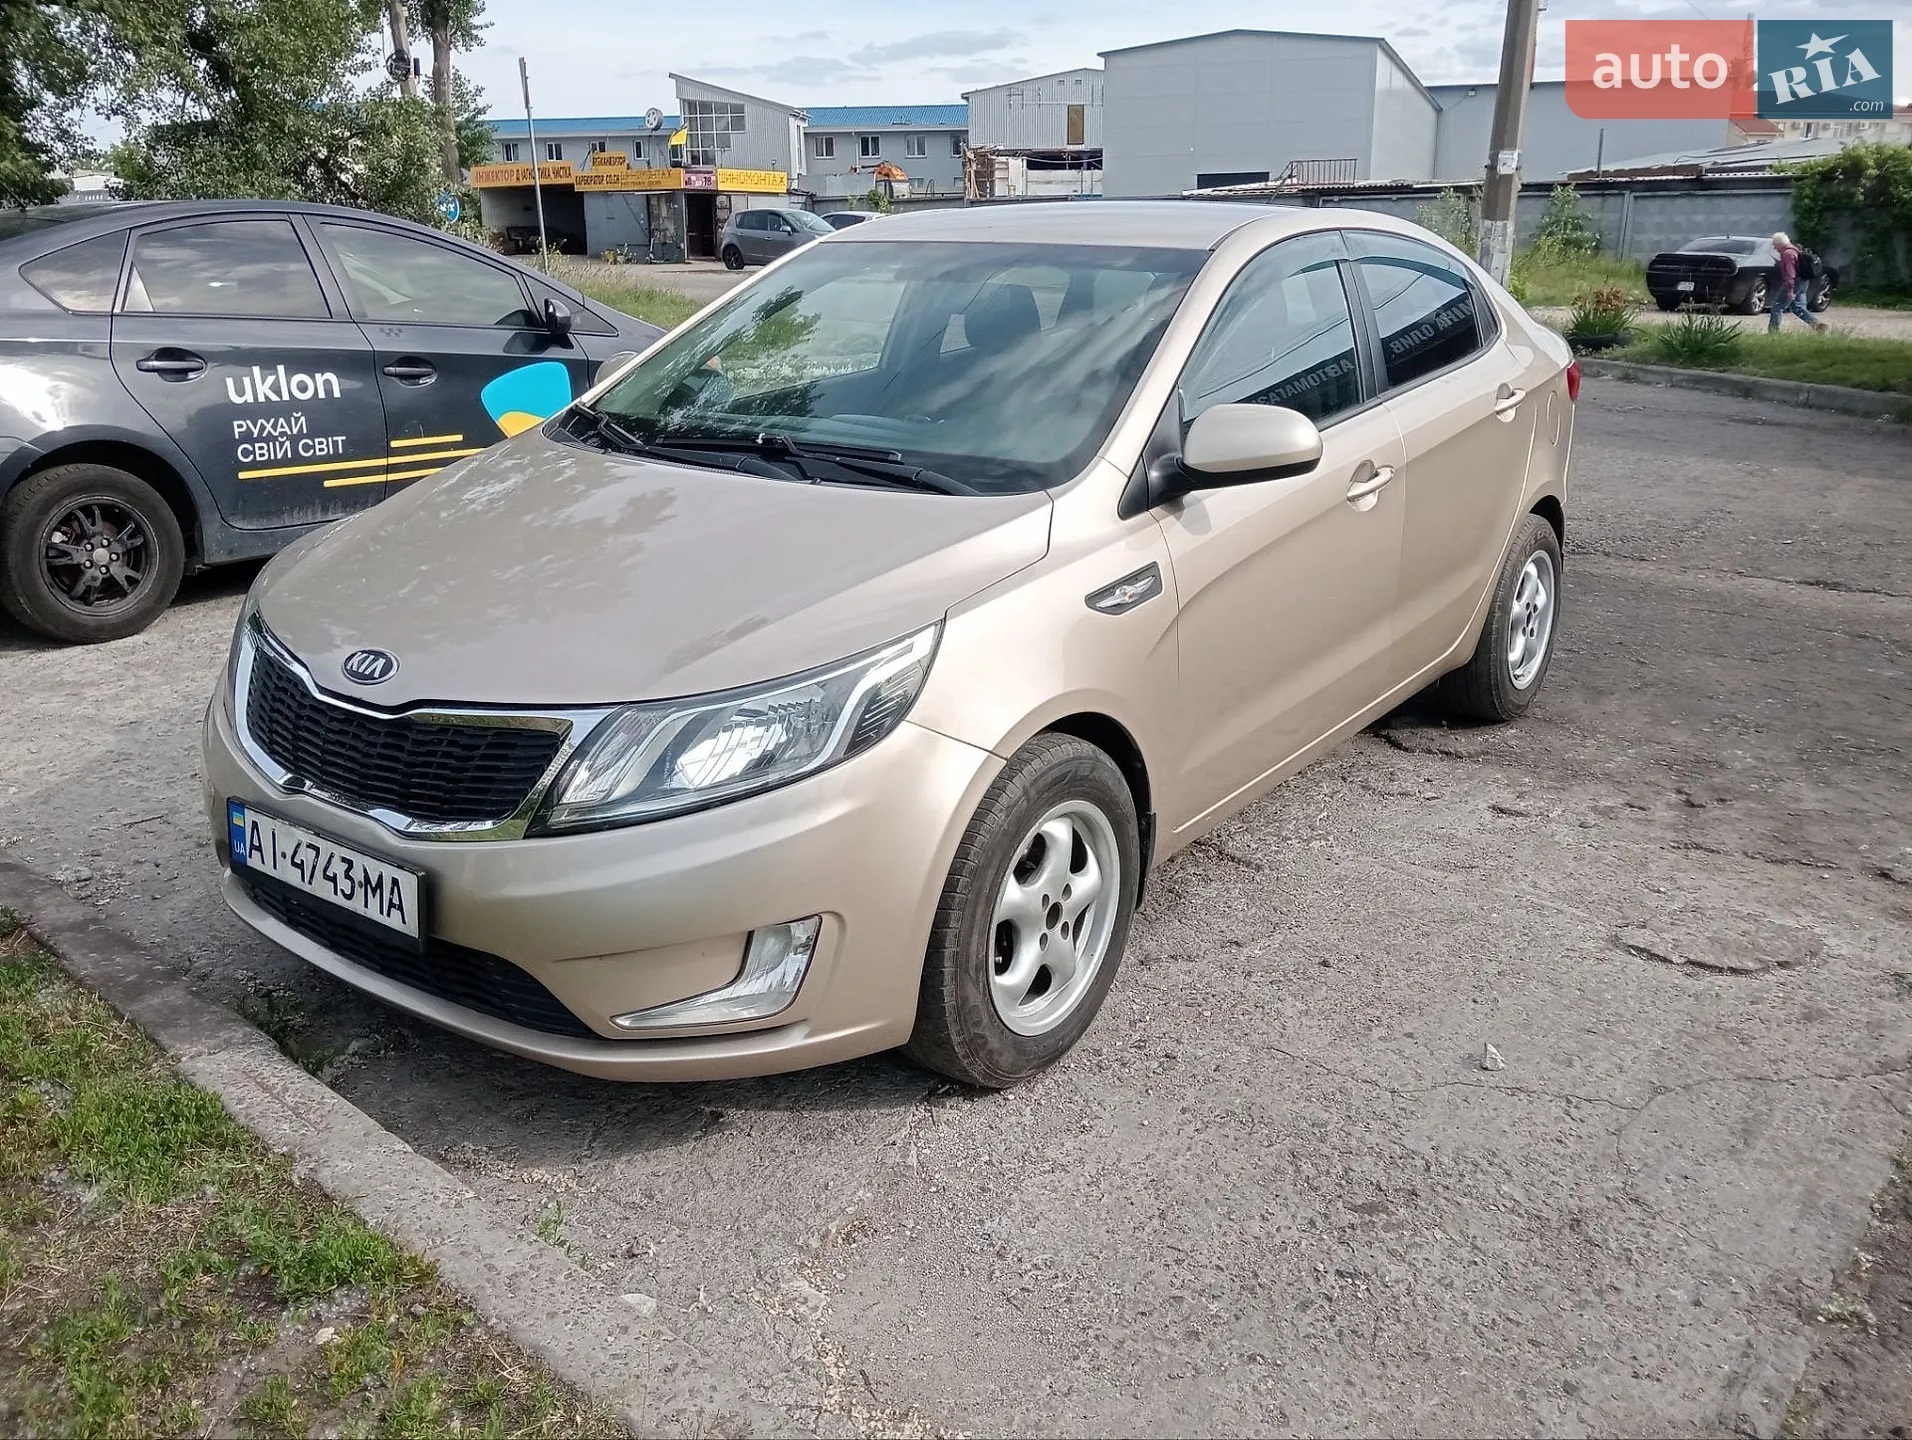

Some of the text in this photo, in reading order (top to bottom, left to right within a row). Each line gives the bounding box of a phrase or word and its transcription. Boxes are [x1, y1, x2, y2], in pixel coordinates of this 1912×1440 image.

[226, 365, 341, 404] uklon
[233, 412, 307, 439] РУХАЙ
[237, 436, 346, 462] СВІЙ СВІТ
[346, 652, 386, 678] KIA
[234, 838, 246, 855] UA
